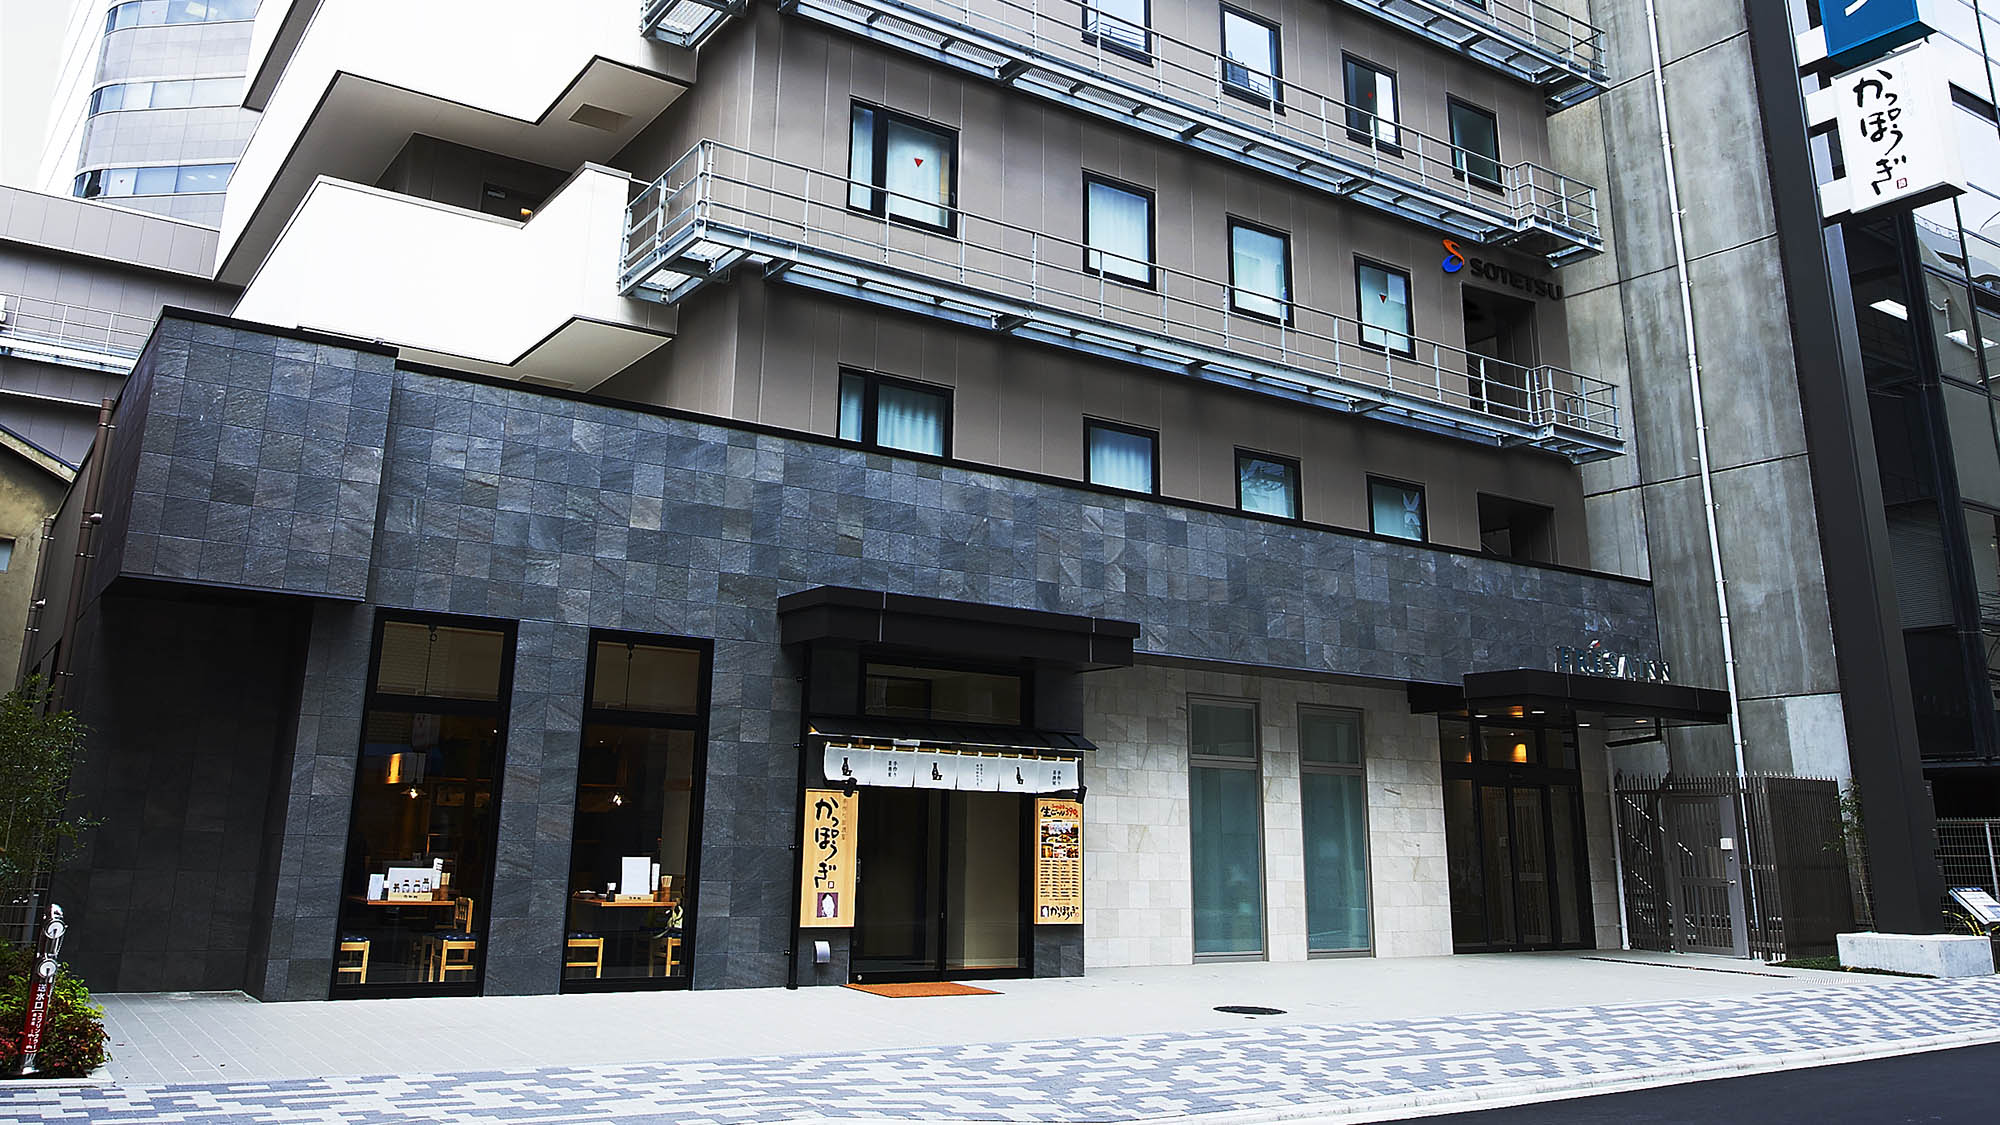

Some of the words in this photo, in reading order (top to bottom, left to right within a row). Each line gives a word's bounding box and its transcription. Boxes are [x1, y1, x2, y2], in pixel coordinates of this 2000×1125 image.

[1853, 69, 1907, 195] かっぽうぎ
[1469, 257, 1564, 301] SOTETSU
[814, 797, 839, 888] かっぽうぎ
[34, 983, 46, 1009] 送水口
